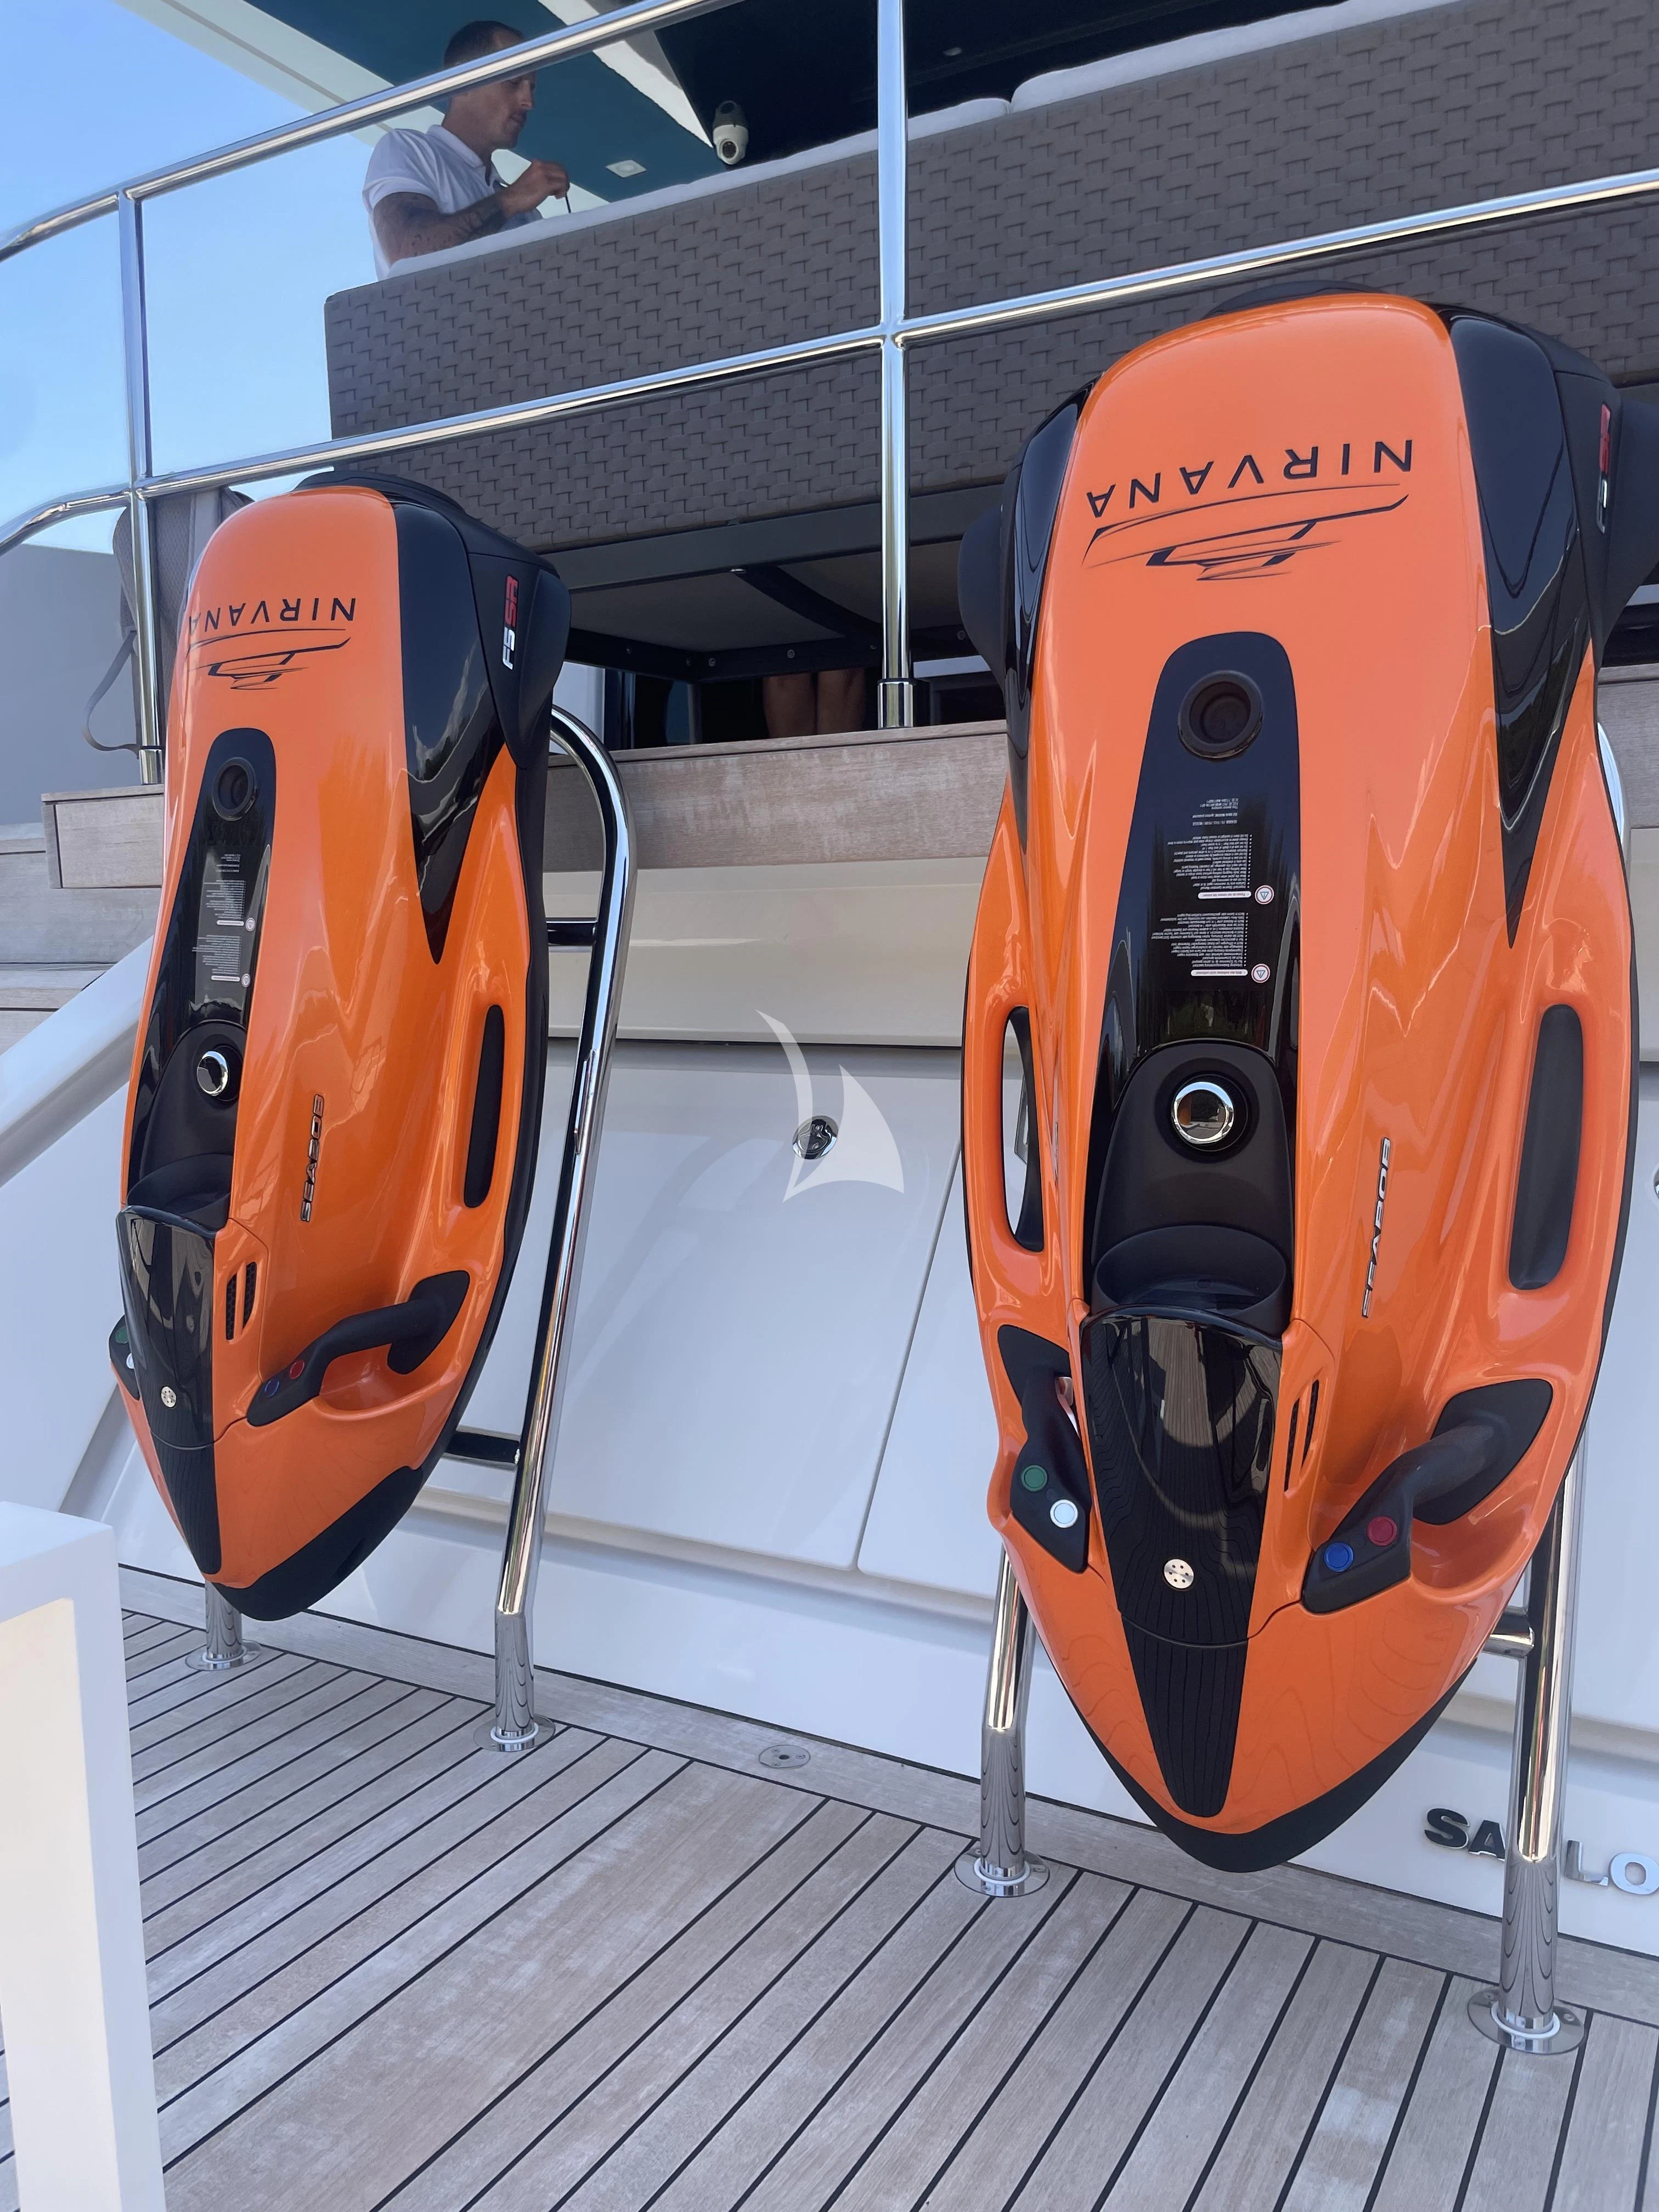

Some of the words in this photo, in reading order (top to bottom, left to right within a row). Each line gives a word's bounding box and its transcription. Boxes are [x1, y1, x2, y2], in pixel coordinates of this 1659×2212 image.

[1087, 440, 1412, 518] NIRVANA
[189, 598, 356, 636] NIRVANA
[301, 1094, 324, 1222] SEABOB
[1362, 1137, 1391, 1318] SEABOB
